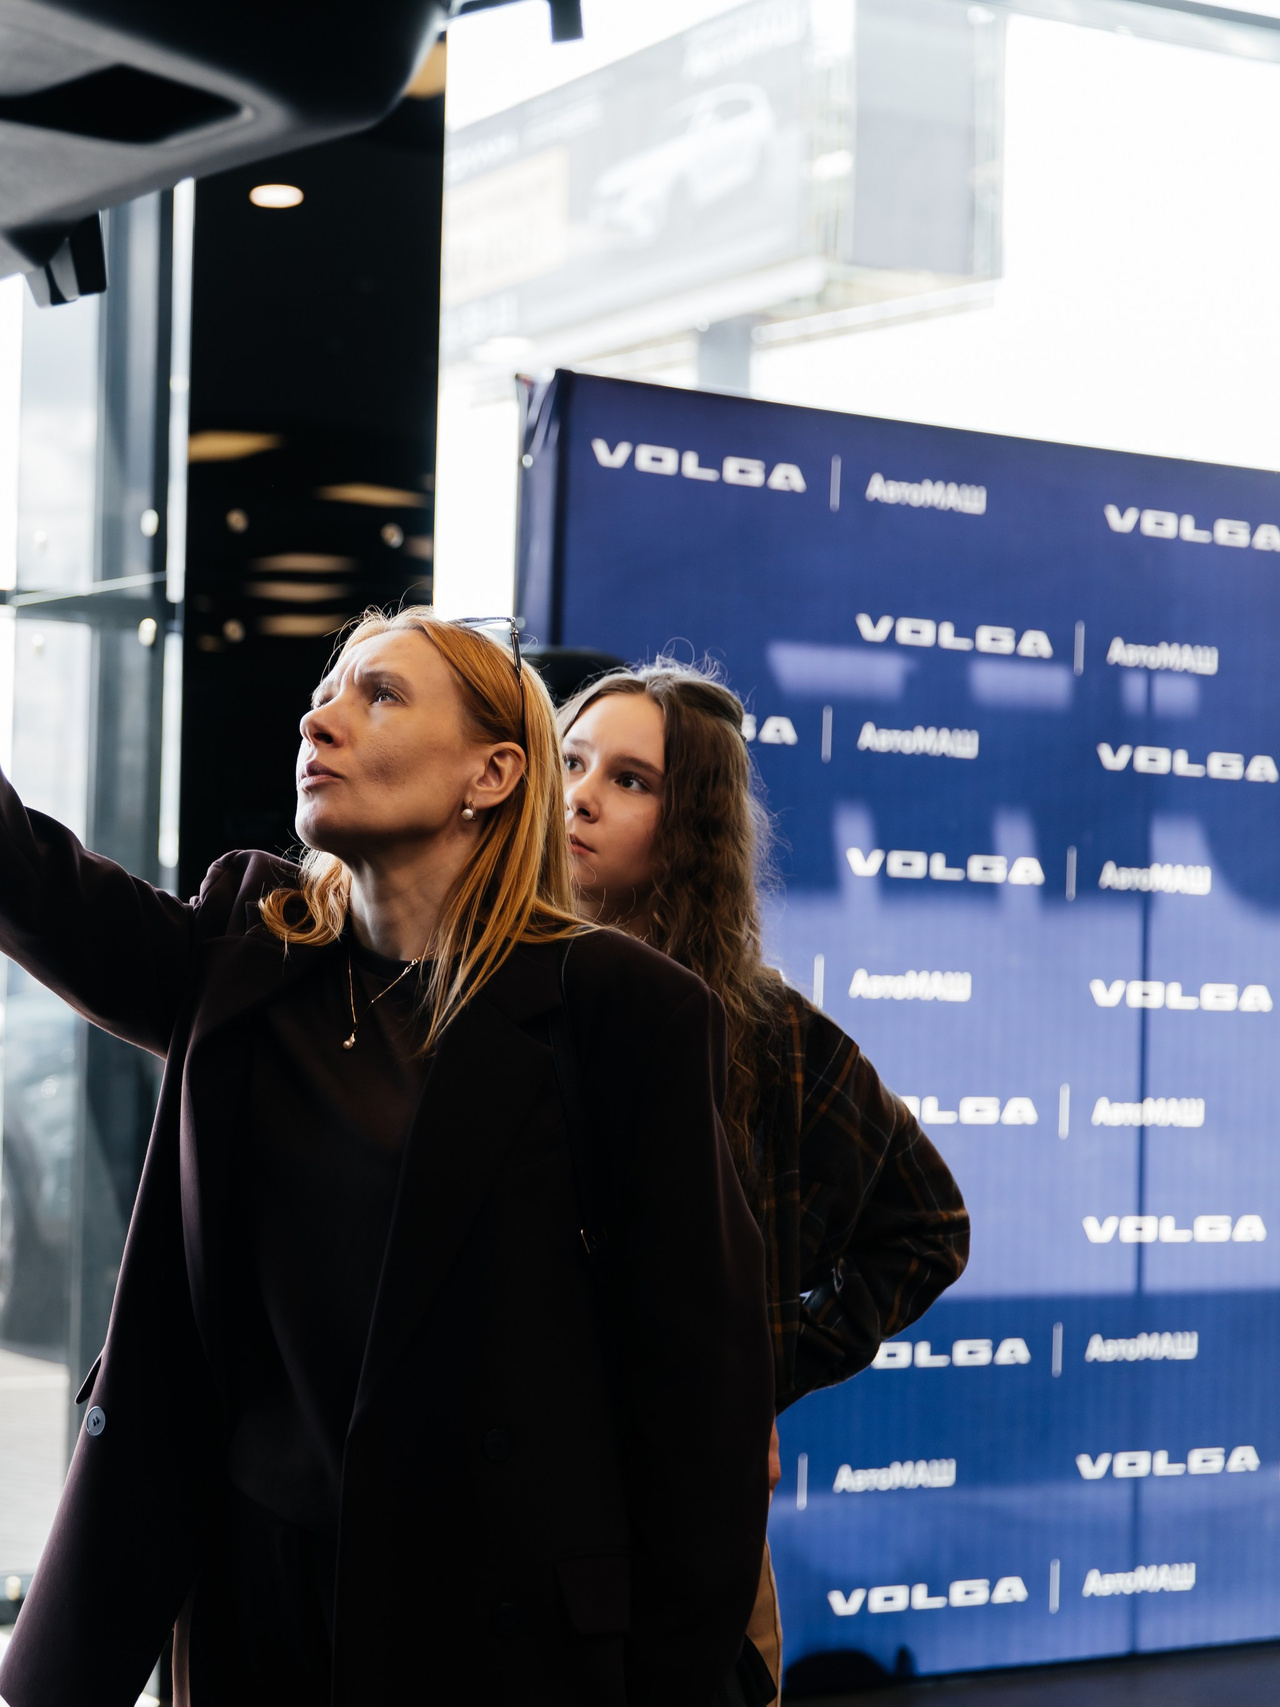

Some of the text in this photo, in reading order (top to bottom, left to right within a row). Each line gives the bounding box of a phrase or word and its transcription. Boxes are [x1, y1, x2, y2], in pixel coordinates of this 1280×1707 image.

[591, 437, 807, 493] VOLGA
[1103, 503, 1280, 553] VOLGA
[855, 612, 1054, 659] VOLGA
[1096, 742, 1280, 784] VOLGA
[845, 847, 1046, 886] VOLGA
[1089, 978, 1274, 1013] VOLGA
[900, 1095, 1039, 1126] LGA
[1082, 1214, 1268, 1244] VOLGA
[871, 1337, 1032, 1370] OLGA
[1075, 1445, 1262, 1481] VOLGA
[827, 1575, 1029, 1618] VOLGA
